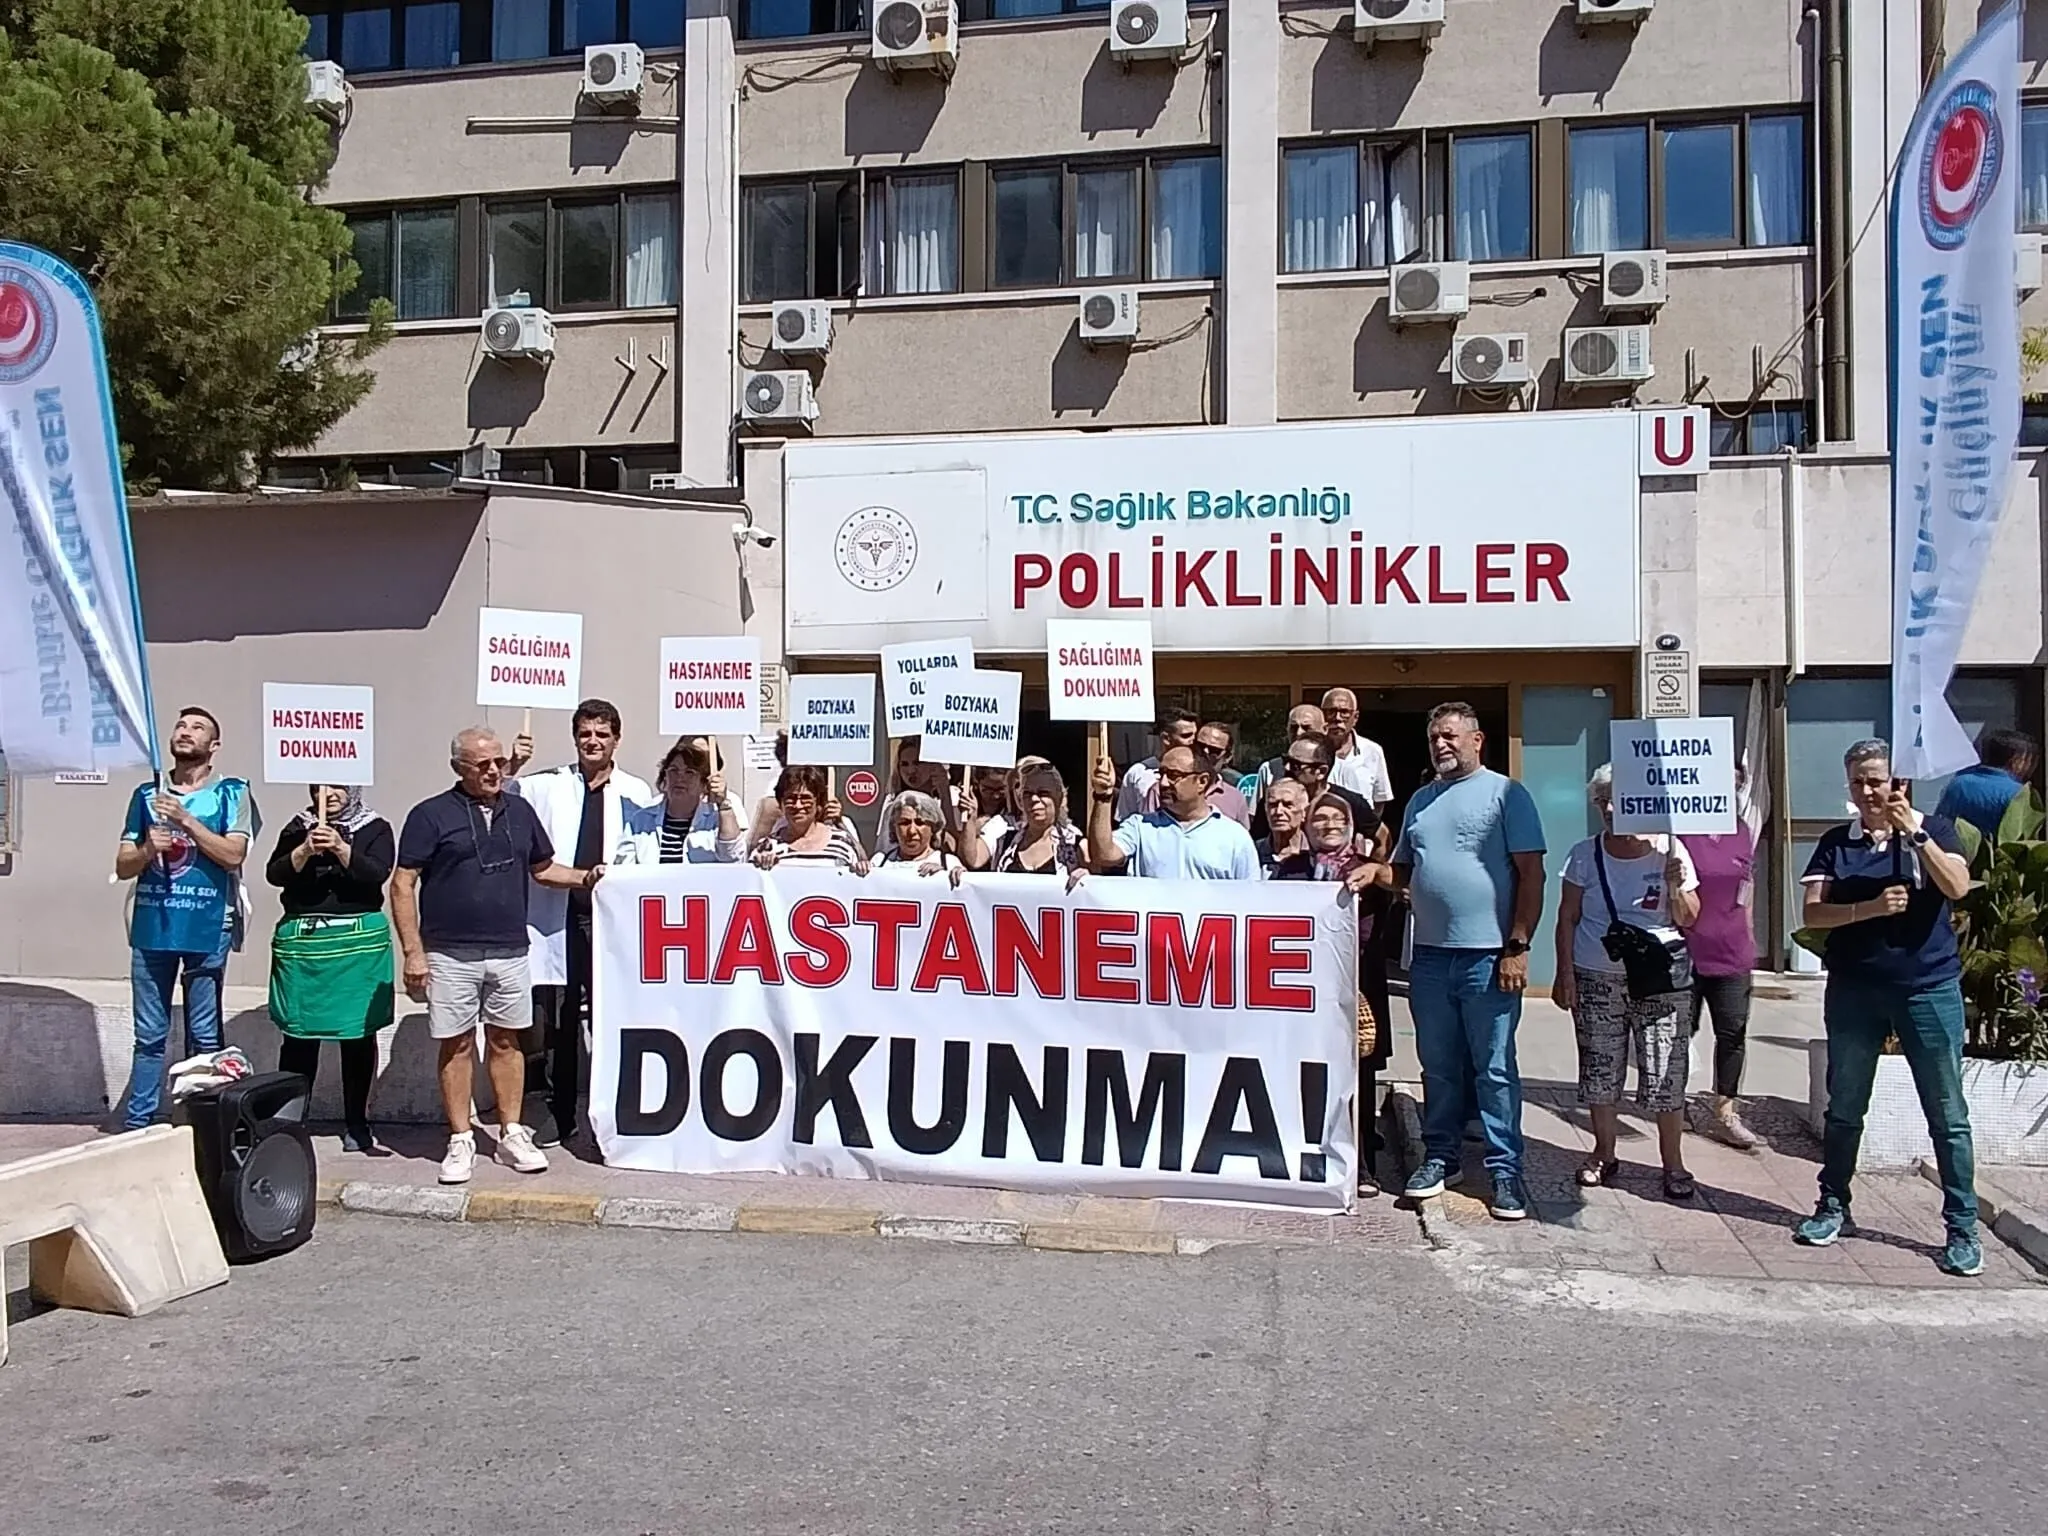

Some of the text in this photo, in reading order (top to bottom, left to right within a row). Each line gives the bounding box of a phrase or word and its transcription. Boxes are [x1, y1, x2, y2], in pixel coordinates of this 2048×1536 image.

[1654, 416, 1694, 466] U
[1011, 486, 1351, 530] T.C. Sağlık Bakanlığı
[1014, 530, 1572, 610] POLİKLİNİKLER
[488, 633, 571, 659] SAĞLIĞIMA
[1058, 641, 1143, 667] SAĞLIĞIMA
[669, 662, 753, 680] HASTANEME
[897, 655, 958, 674] YOLLARDA
[490, 665, 566, 687] DOKUNMA
[1064, 678, 1141, 697] DOKUNMA
[674, 691, 746, 709] DOKUNMA
[807, 699, 856, 714] BOZYAKA
[944, 694, 999, 714] BOZYAKA
[273, 709, 364, 730] HASTANEME
[925, 719, 1014, 741] KAPATILMASIN!
[791, 723, 870, 739] KAPATILMASIN!
[280, 739, 357, 759] DOKUNMA
[1632, 738, 1713, 757] YOLLARDA
[1646, 763, 1700, 786] ÖLMEK
[849, 782, 875, 796] ÇIKIŞ
[1620, 792, 1728, 815] İSTEMİYORUZ!
[197, 886, 218, 897] SEN
[638, 894, 1316, 1013] HASTANEME
[614, 1027, 1329, 1184] DOKUNMA!
